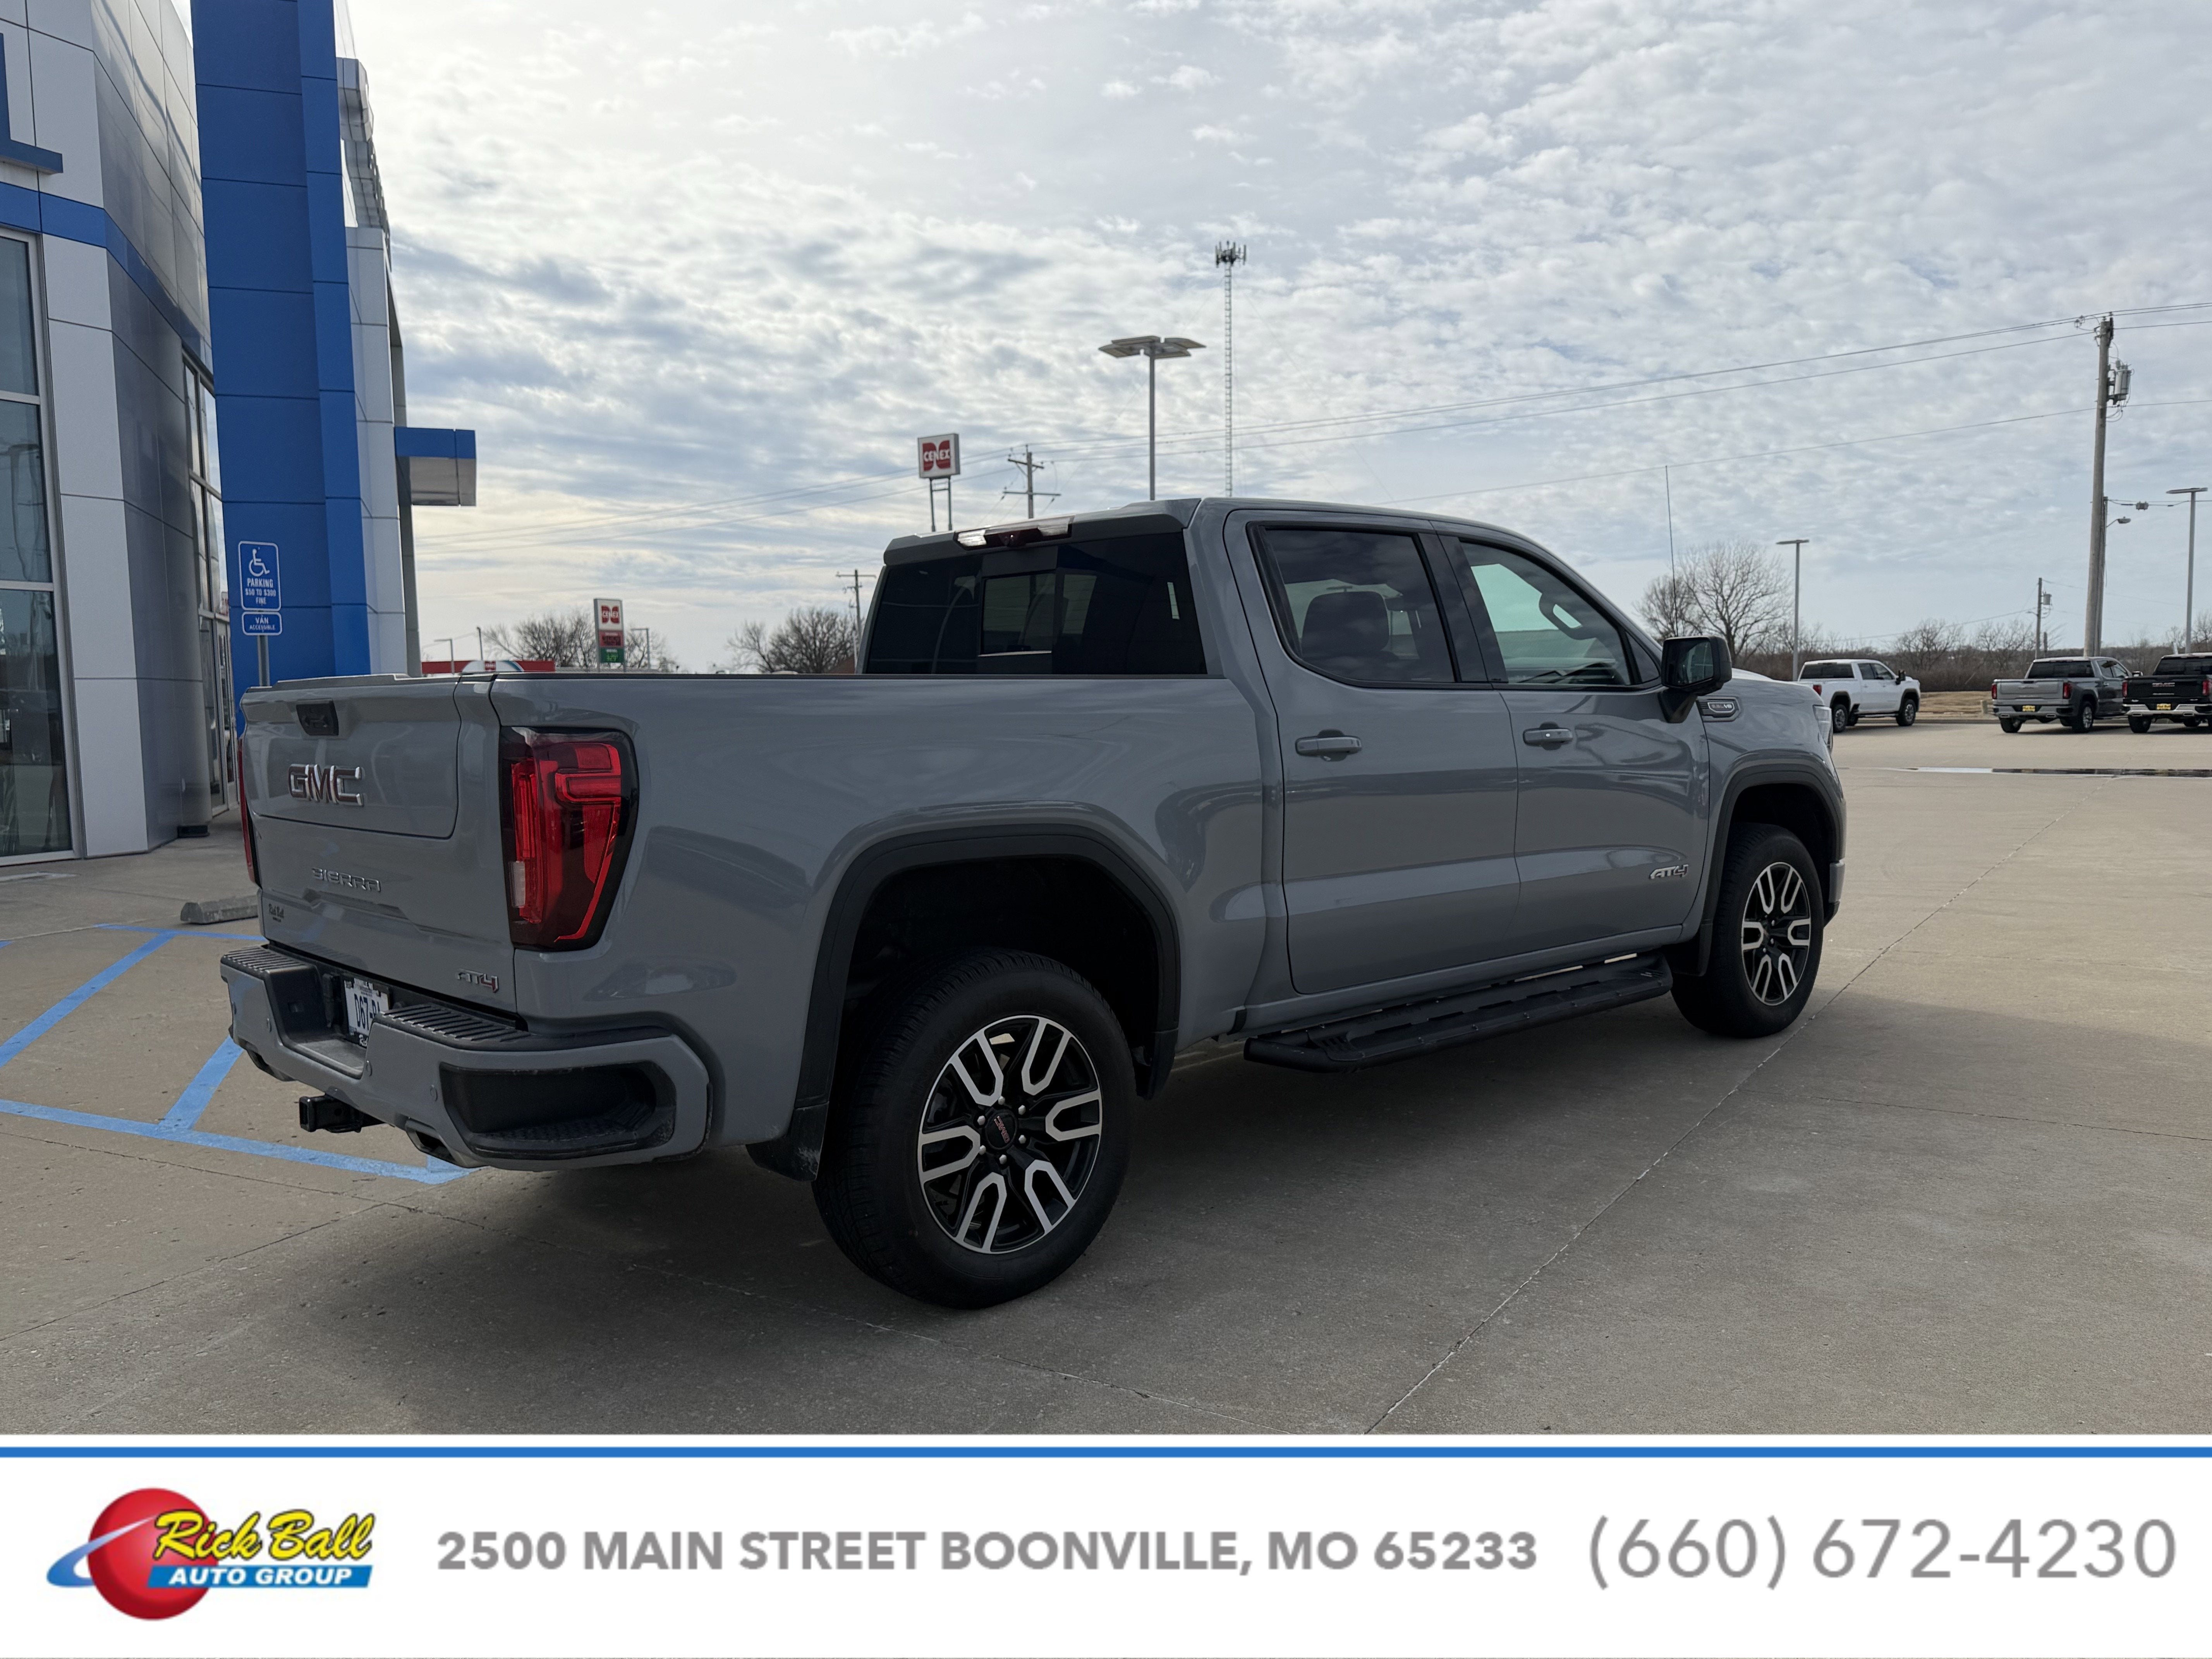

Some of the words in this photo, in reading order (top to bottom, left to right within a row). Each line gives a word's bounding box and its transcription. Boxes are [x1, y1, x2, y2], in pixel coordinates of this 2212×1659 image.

[247, 578, 273, 588] PARKING
[289, 764, 364, 807] GMC
[311, 867, 381, 893] SIERRA
[1649, 864, 1688, 879] AT4
[457, 968, 500, 994] AT4
[994, 1116, 1010, 1144] GMC
